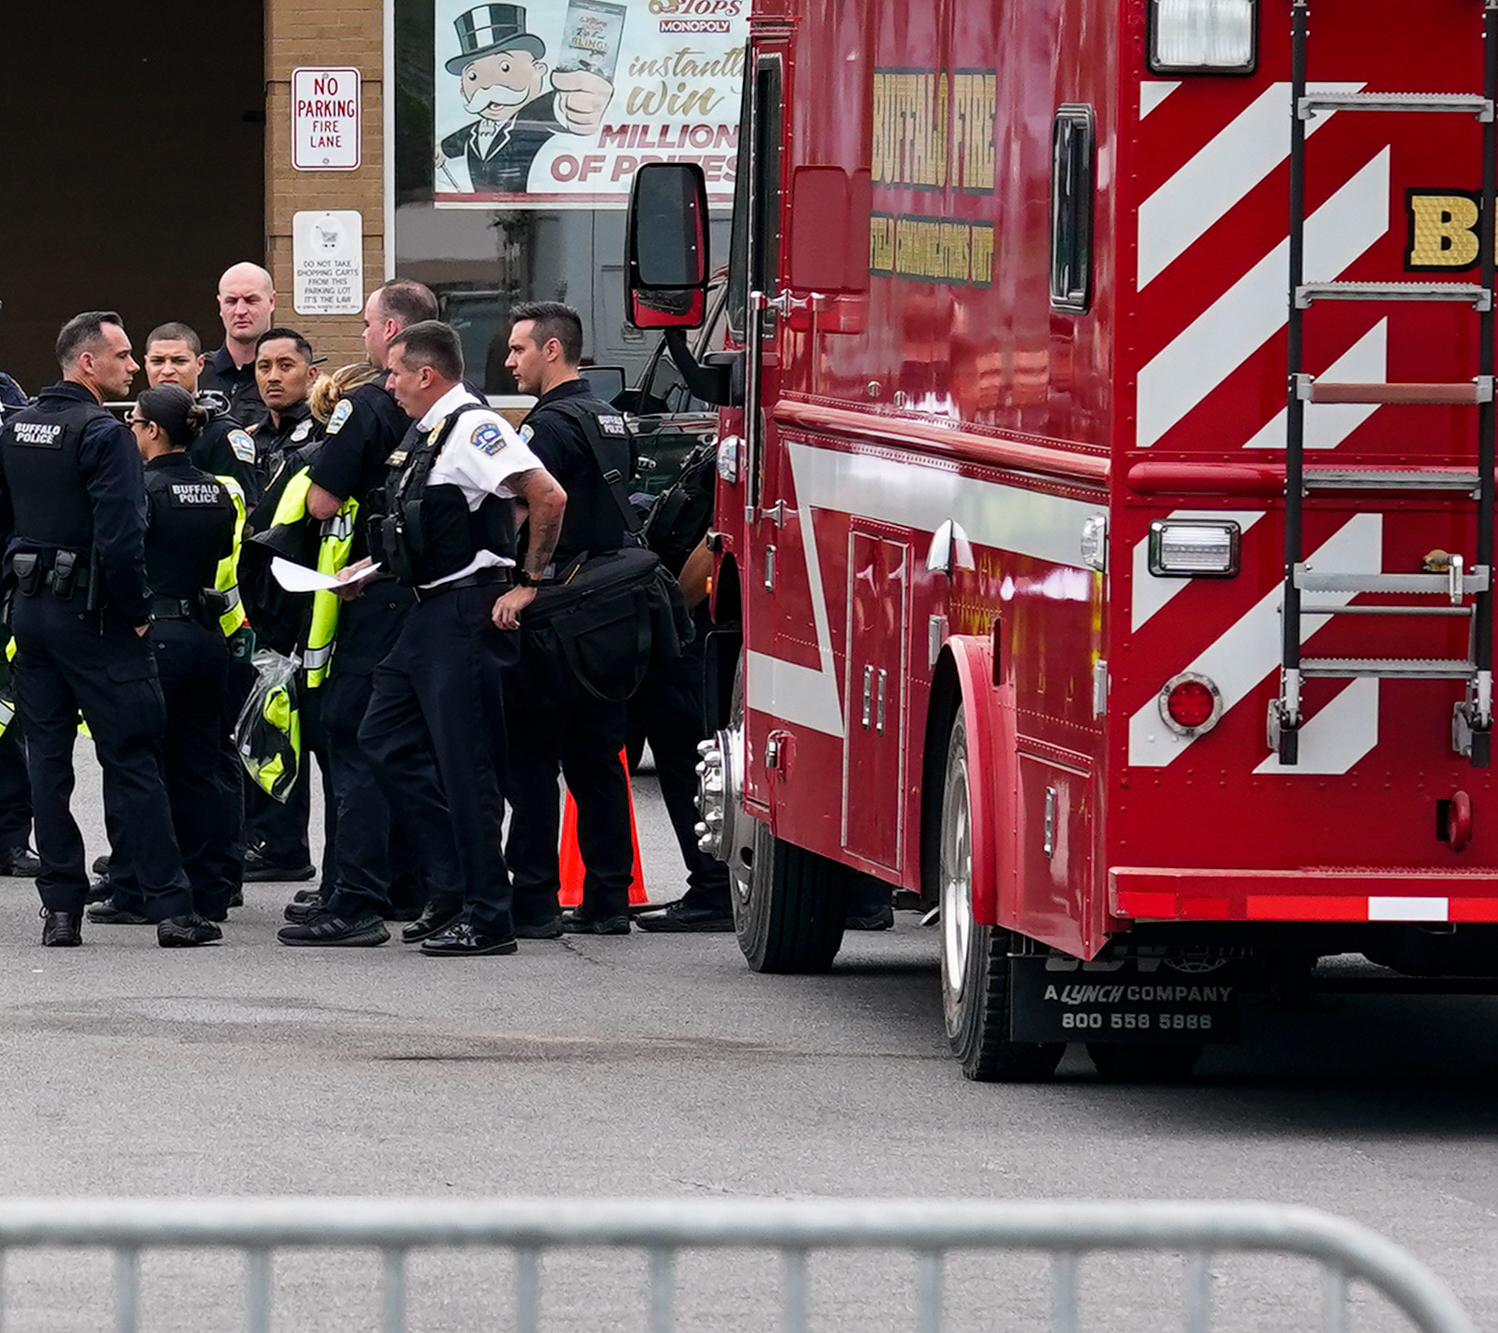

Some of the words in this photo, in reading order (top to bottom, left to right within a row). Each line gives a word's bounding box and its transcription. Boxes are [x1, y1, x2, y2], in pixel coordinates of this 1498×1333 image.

[660, 20, 730, 33] MONOPOLY
[628, 47, 745, 78] instantl
[314, 77, 338, 96] NO
[298, 99, 355, 118] PARKING
[313, 120, 339, 133] FIRE
[871, 72, 949, 188] BUFFALO
[953, 73, 997, 189] FIRE
[310, 135, 342, 148] LANE
[597, 124, 740, 149] MILLION
[550, 154, 606, 182] OF
[317, 260, 331, 268] NOT
[14, 422, 61, 435] BUFFALO
[16, 432, 54, 444] POLICE
[171, 484, 220, 494] BUFFALO
[179, 493, 218, 504] POLICE
[1044, 985, 1058, 1000] A
[1060, 985, 1124, 1005] LYNCH
[1126, 986, 1233, 1002] COMPANY
[1061, 1012, 1103, 1029] 800
